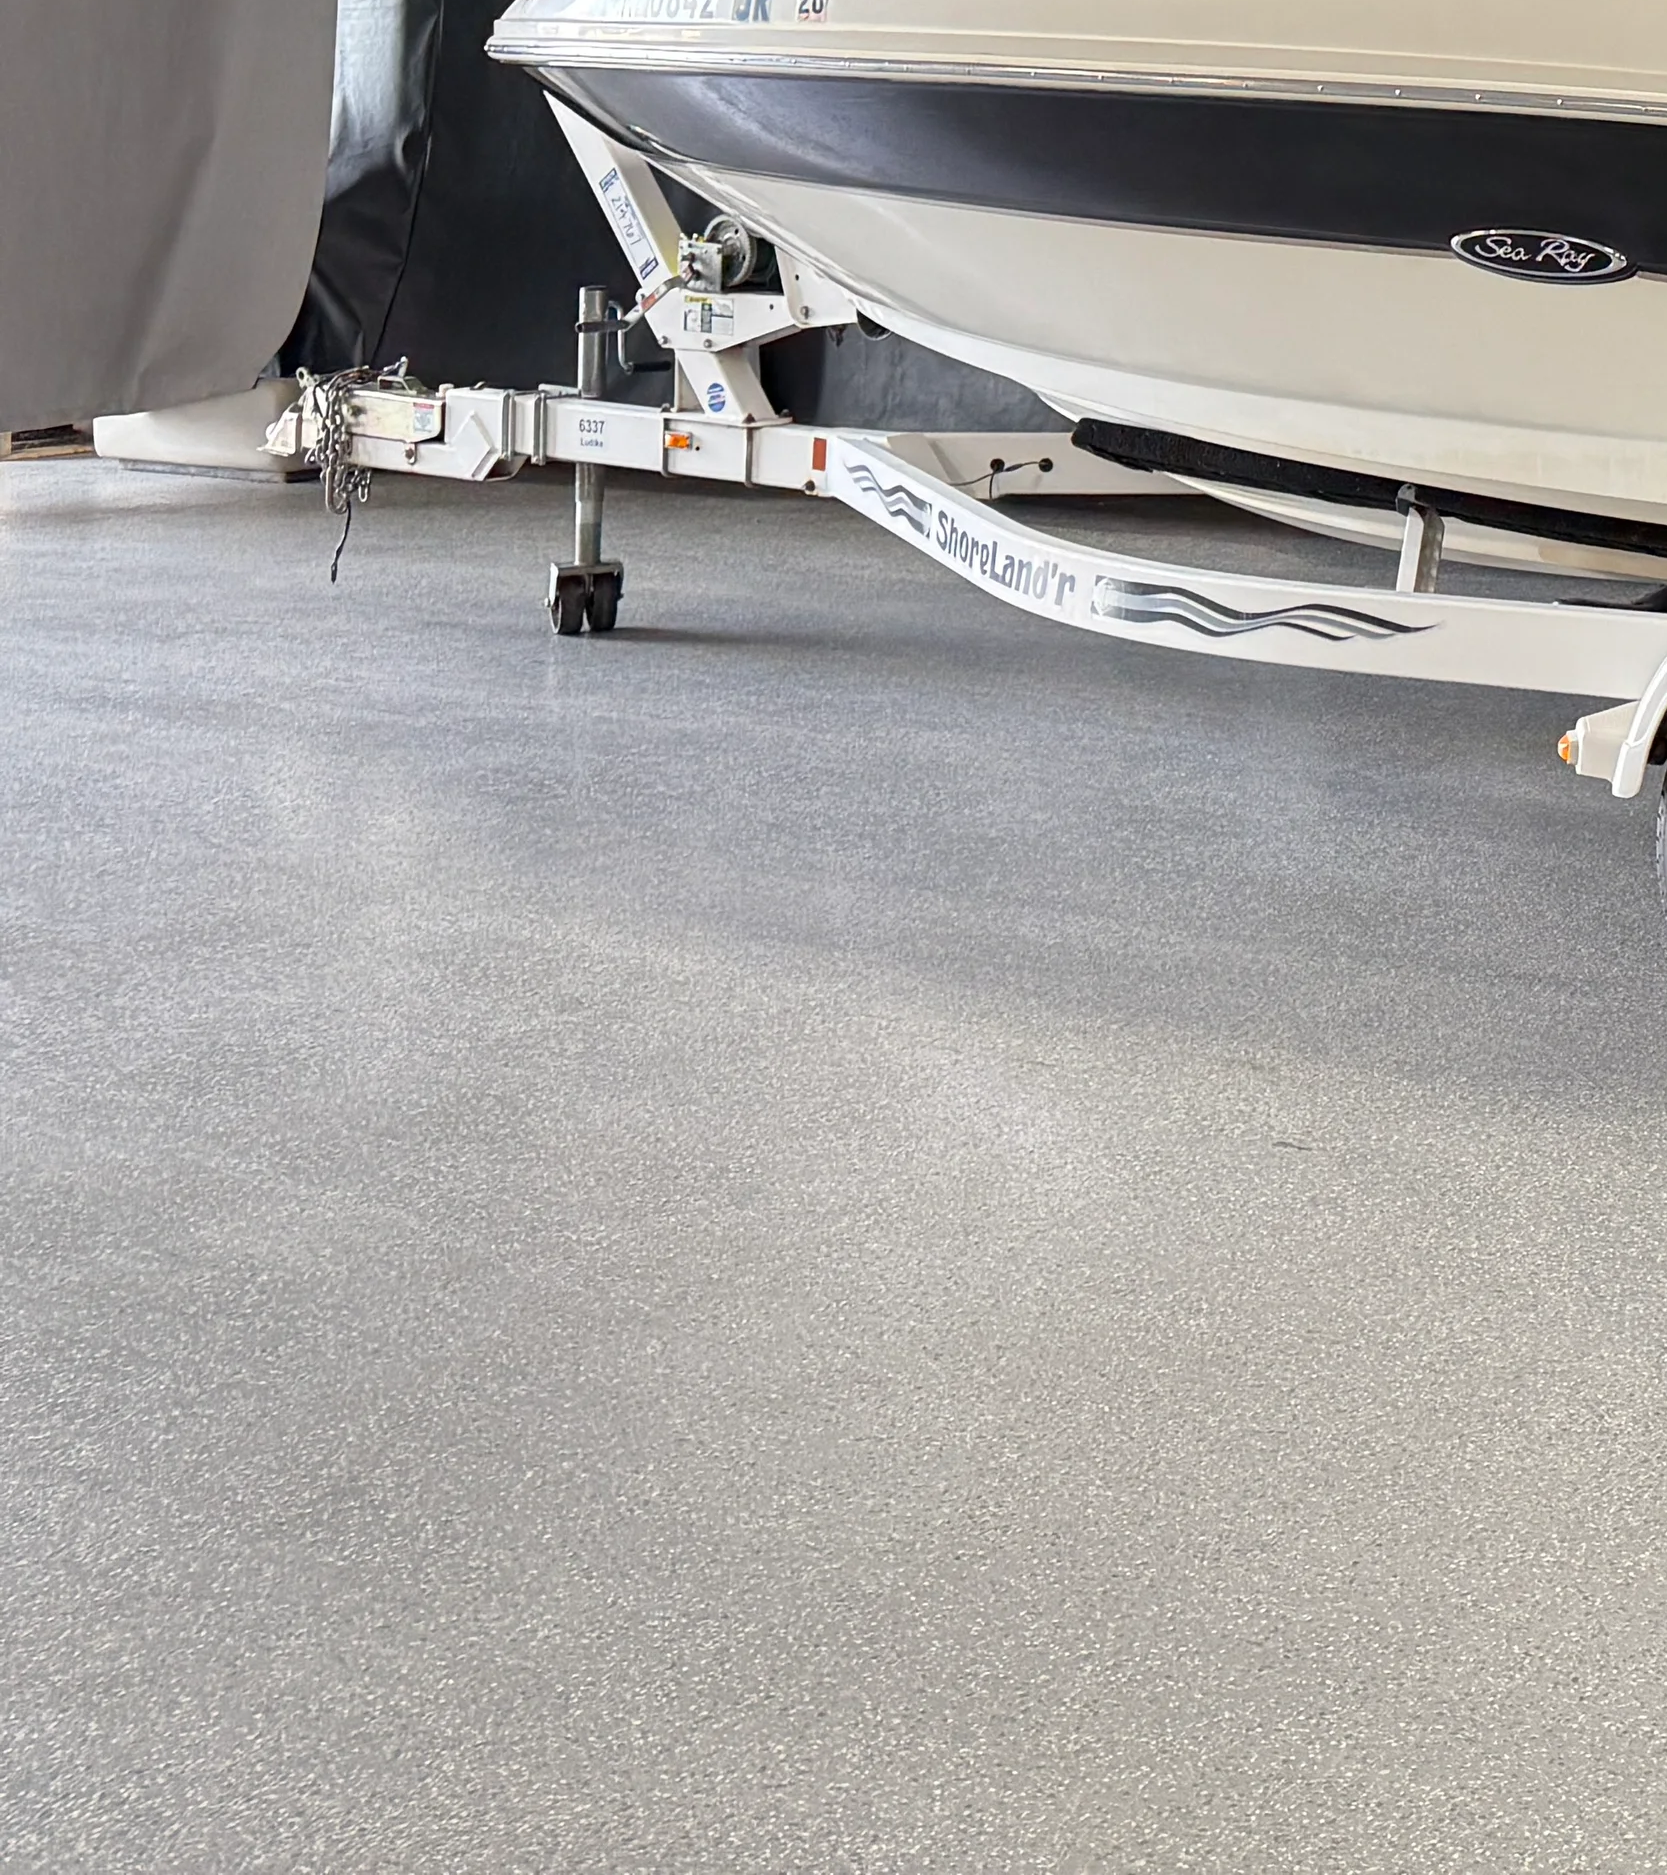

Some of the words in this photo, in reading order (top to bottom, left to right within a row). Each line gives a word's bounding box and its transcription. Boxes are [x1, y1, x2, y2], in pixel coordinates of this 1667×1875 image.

[1474, 236, 1532, 261] Sea
[1535, 238, 1596, 273] Ray
[579, 418, 605, 434] 6337
[936, 510, 1076, 606] ShoreLand'r
